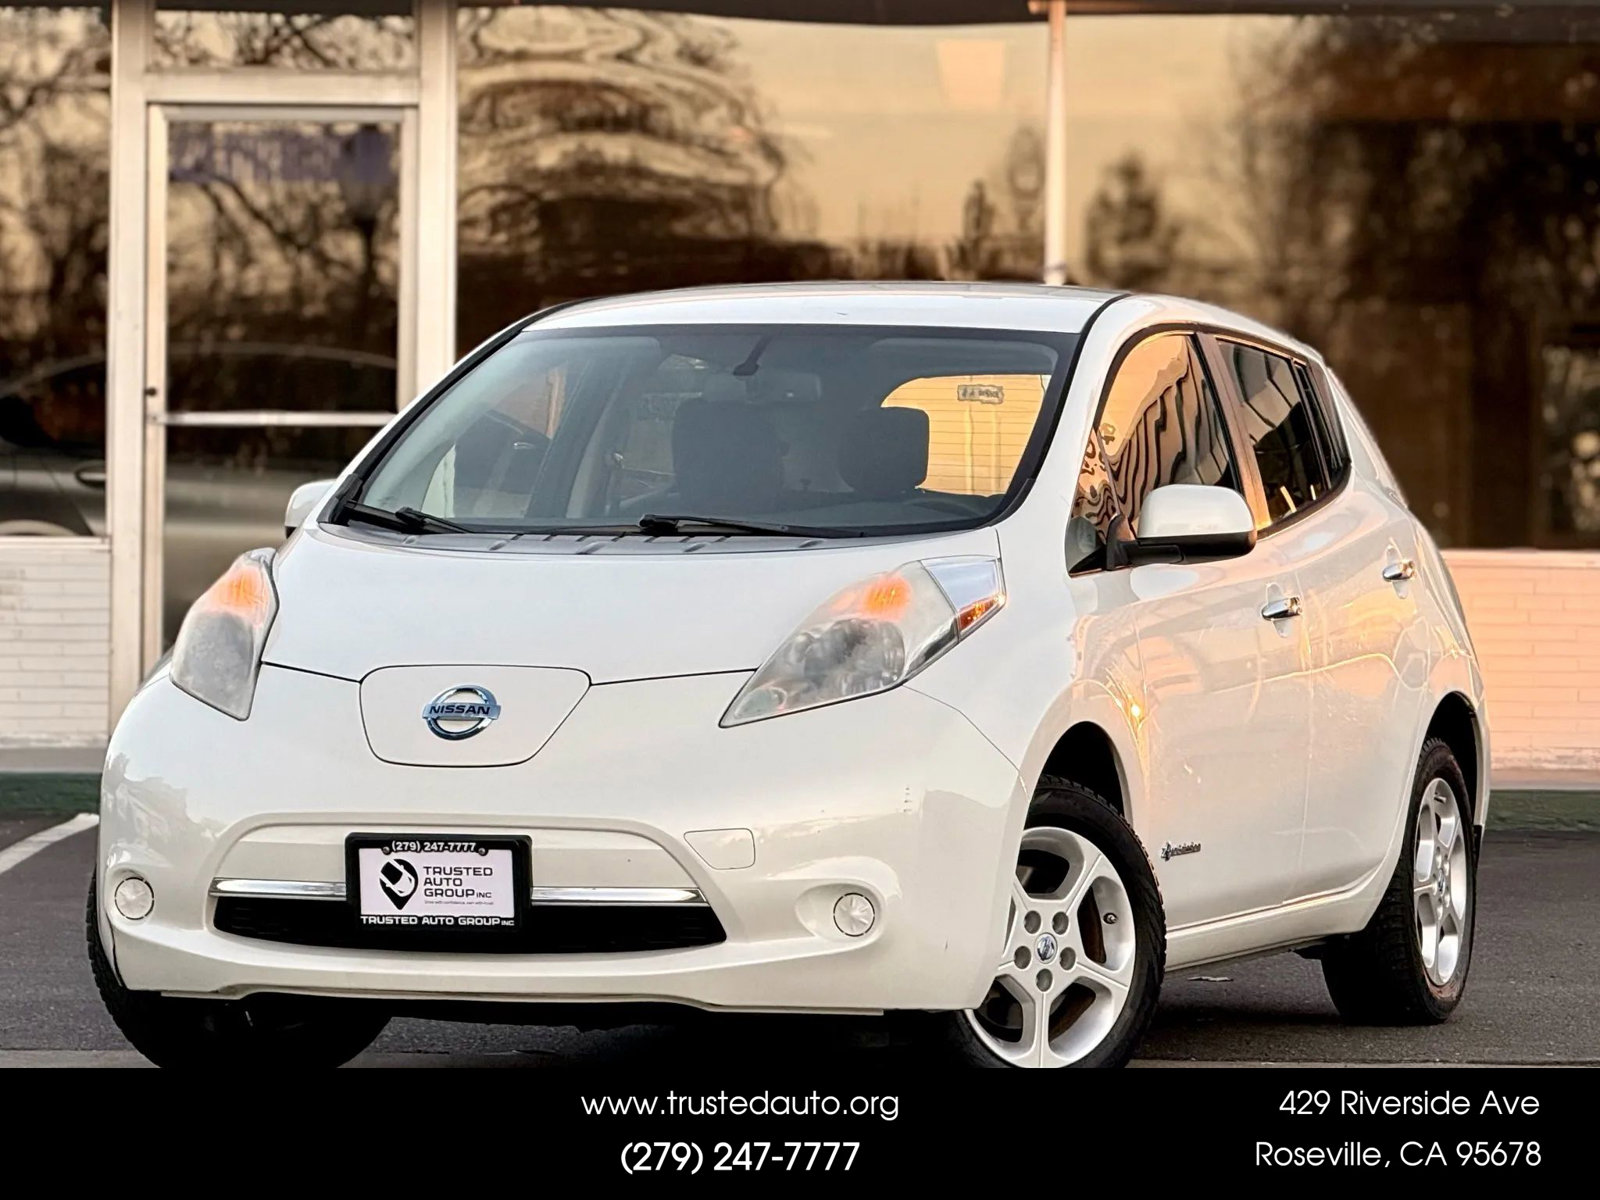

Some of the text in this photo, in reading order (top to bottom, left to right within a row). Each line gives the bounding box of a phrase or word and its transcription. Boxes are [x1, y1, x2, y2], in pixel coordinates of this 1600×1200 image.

[429, 705, 491, 715] NISSAN
[391, 840, 477, 853] (279) 247-7777
[423, 866, 493, 876] TRUSTED
[423, 877, 463, 887] AUTO
[424, 888, 475, 898] GROUP
[361, 915, 418, 925] TRUSTED
[421, 916, 454, 925] AUTO
[458, 917, 500, 926] GROUP
